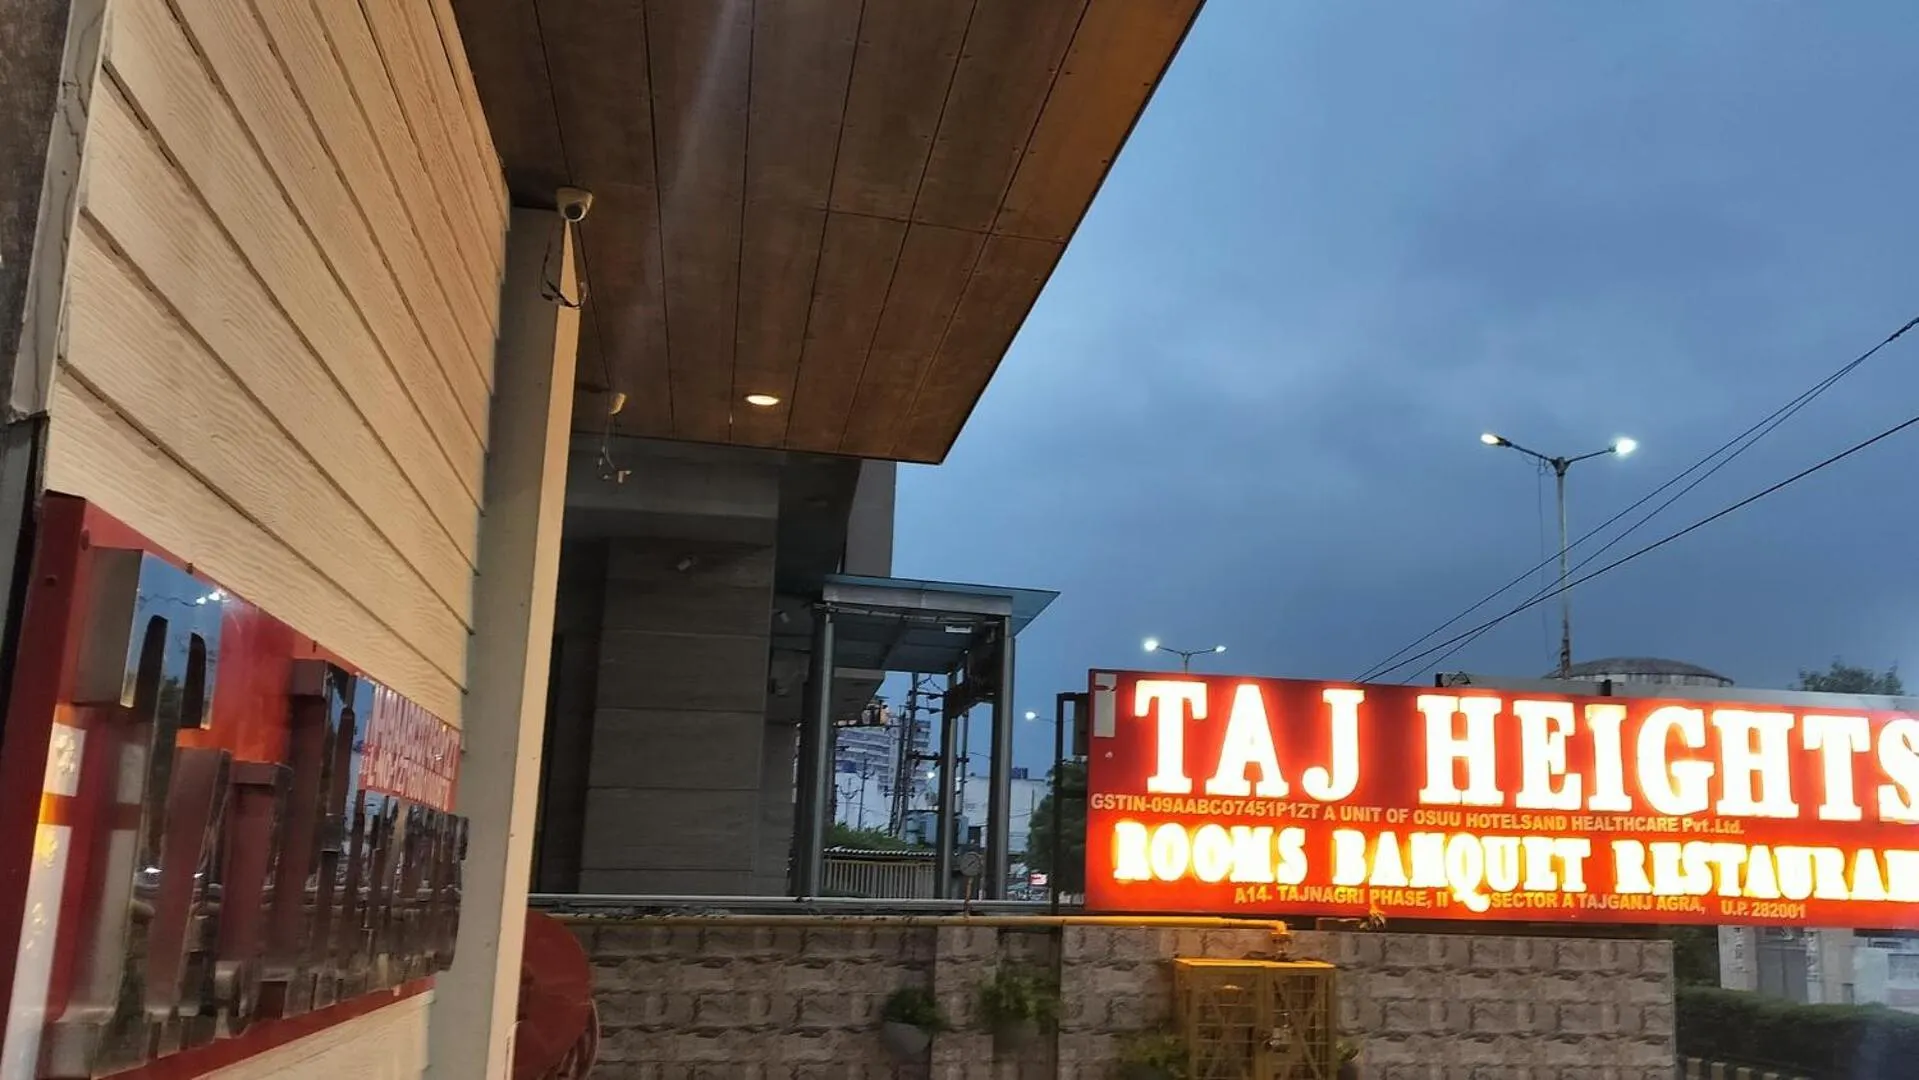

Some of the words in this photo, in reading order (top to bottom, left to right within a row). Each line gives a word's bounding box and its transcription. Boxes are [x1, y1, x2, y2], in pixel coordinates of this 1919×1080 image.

[1134, 680, 1365, 802] TAJ
[1417, 693, 1919, 822] HEIGHTS
[1323, 806, 1337, 821] A
[1340, 805, 1383, 823] UNIT
[1386, 807, 1409, 824] OF
[1413, 809, 1461, 827] OSUU
[1571, 815, 1680, 833] HEALTHCARE
[1114, 820, 1308, 885] ROOMS
[1332, 828, 1592, 912] BANQUET
[1278, 885, 1365, 905] TAJNAGRI
[1369, 886, 1433, 909] PHASE,
[1437, 891, 1449, 908] II
[1491, 892, 1558, 909] SECTOR
[1562, 893, 1575, 909] A
[1578, 893, 1651, 912] TAJGANJ
[1656, 895, 1706, 915] AGRA,
[1720, 899, 1749, 917] U.P.
[1751, 901, 1807, 919] 282001
